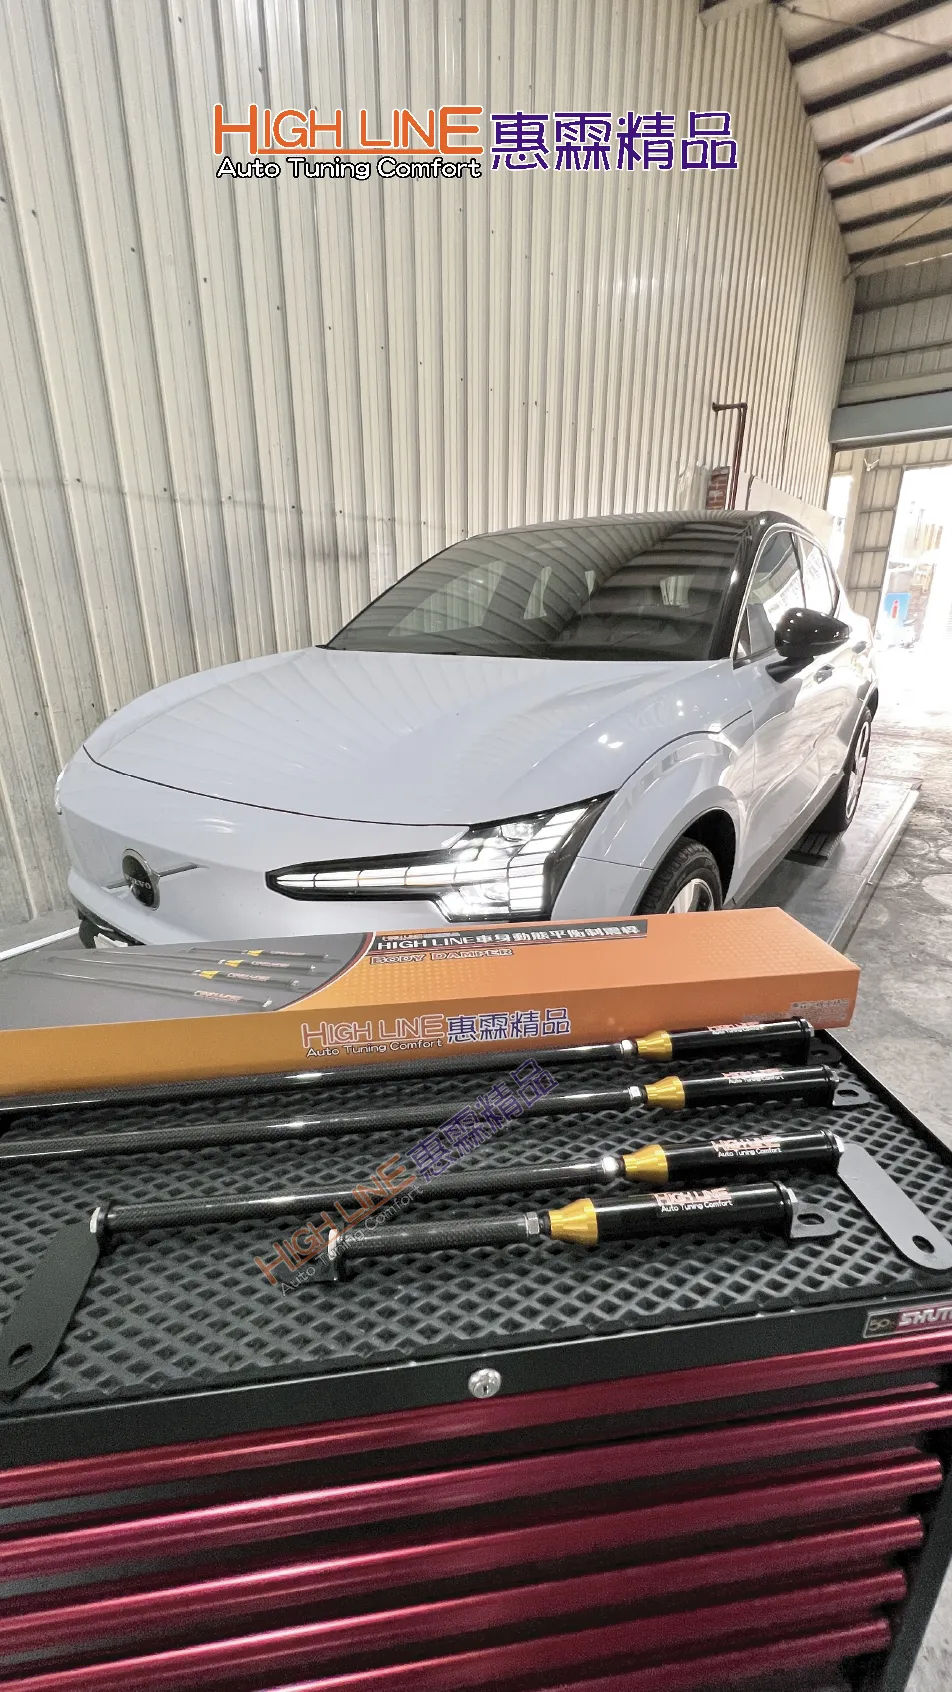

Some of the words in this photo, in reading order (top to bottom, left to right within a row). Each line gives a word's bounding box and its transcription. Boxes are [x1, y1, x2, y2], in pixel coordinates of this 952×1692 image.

[377, 939, 427, 950] HIGH
[432, 936, 475, 946] LINE
[370, 953, 426, 965] BODY
[431, 949, 514, 962] DAMPER
[301, 1021, 372, 1049] HIGH
[378, 1014, 445, 1040] LINE
[447, 1008, 572, 1044] 惠霖精品
[306, 1047, 340, 1057] Auto
[344, 1043, 388, 1054] Tuning
[389, 1038, 443, 1051] Comfort
[735, 1148, 755, 1157] Tuning
[755, 1146, 782, 1155] Comfort
[661, 1205, 679, 1213] Auto
[681, 1202, 704, 1211] Tuning
[703, 1199, 733, 1208] Comfort
